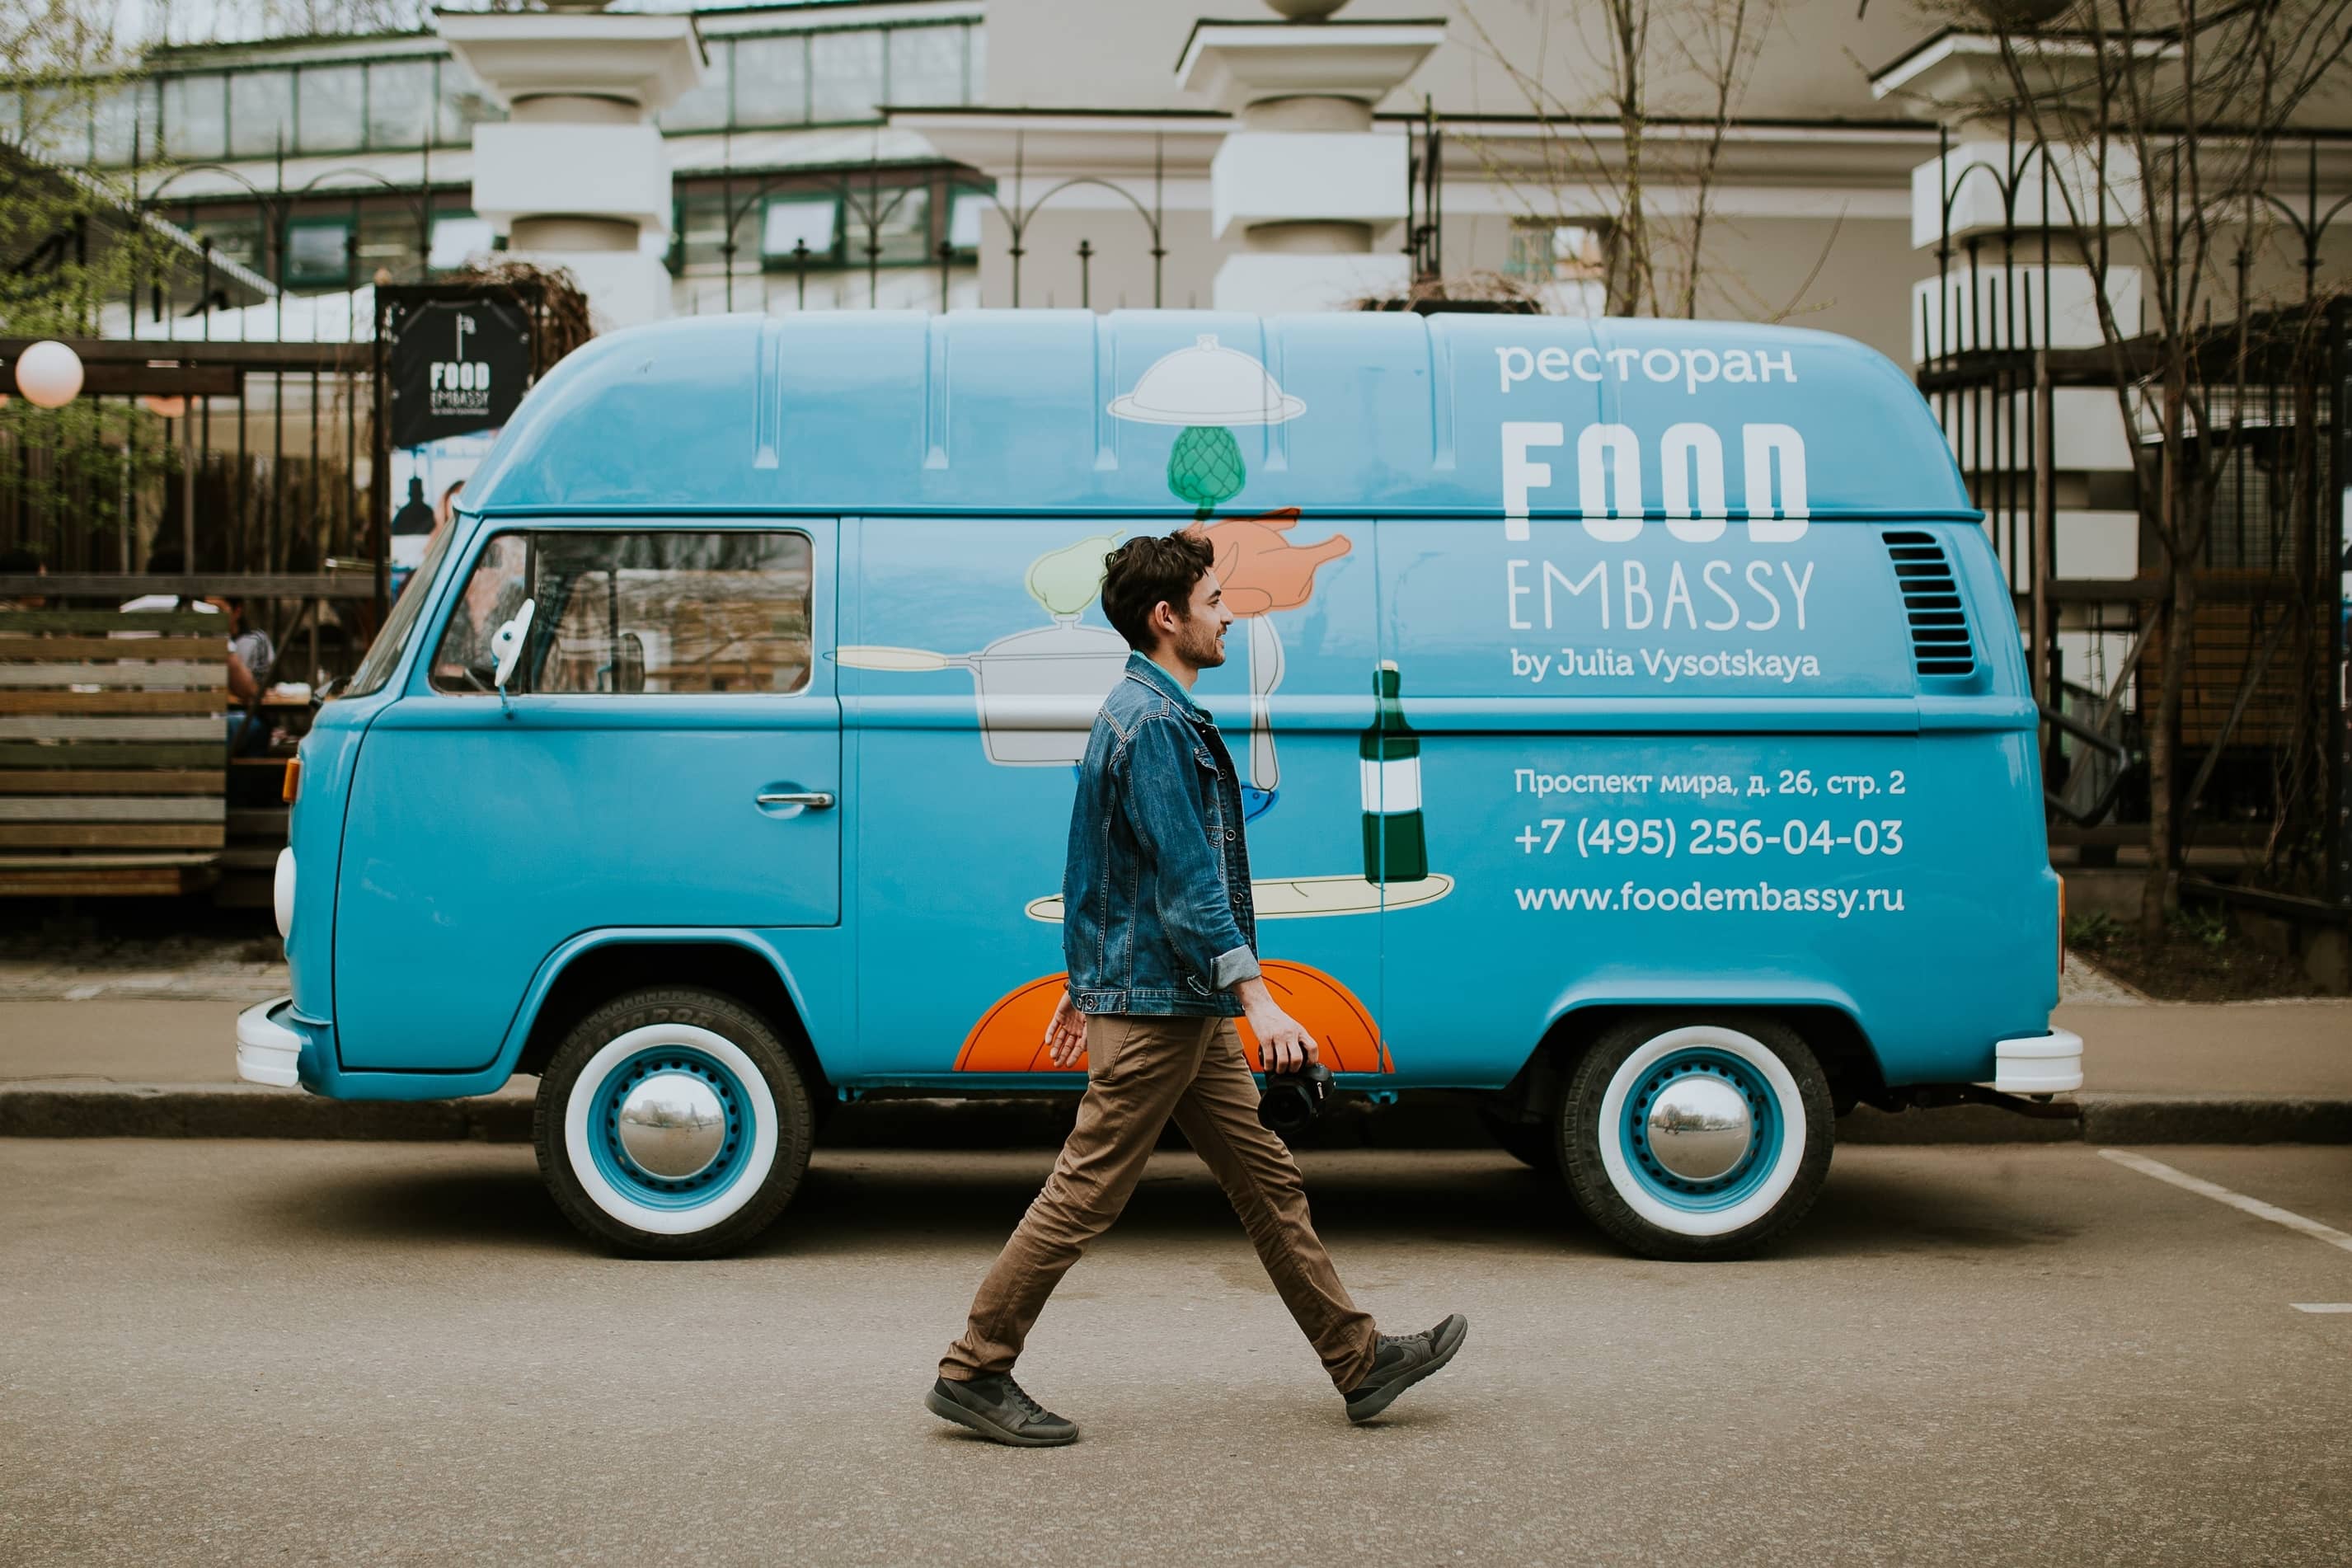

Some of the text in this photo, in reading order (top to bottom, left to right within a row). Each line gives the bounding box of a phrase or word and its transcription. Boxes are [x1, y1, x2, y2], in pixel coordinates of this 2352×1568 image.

[430, 362, 490, 391] FOOD
[1495, 347, 1796, 393] ресторан
[1502, 422, 1809, 542] FOOD
[1508, 560, 1814, 630] EMBASSY
[1511, 648, 1820, 683] by Julia Vysotskaya
[1515, 769, 1905, 799] Проспект мира, д. 26, стр. 2
[1515, 818, 1903, 857] +7 (495) 256-04-03
[1515, 882, 1904, 918] www.foodembassy.ru
